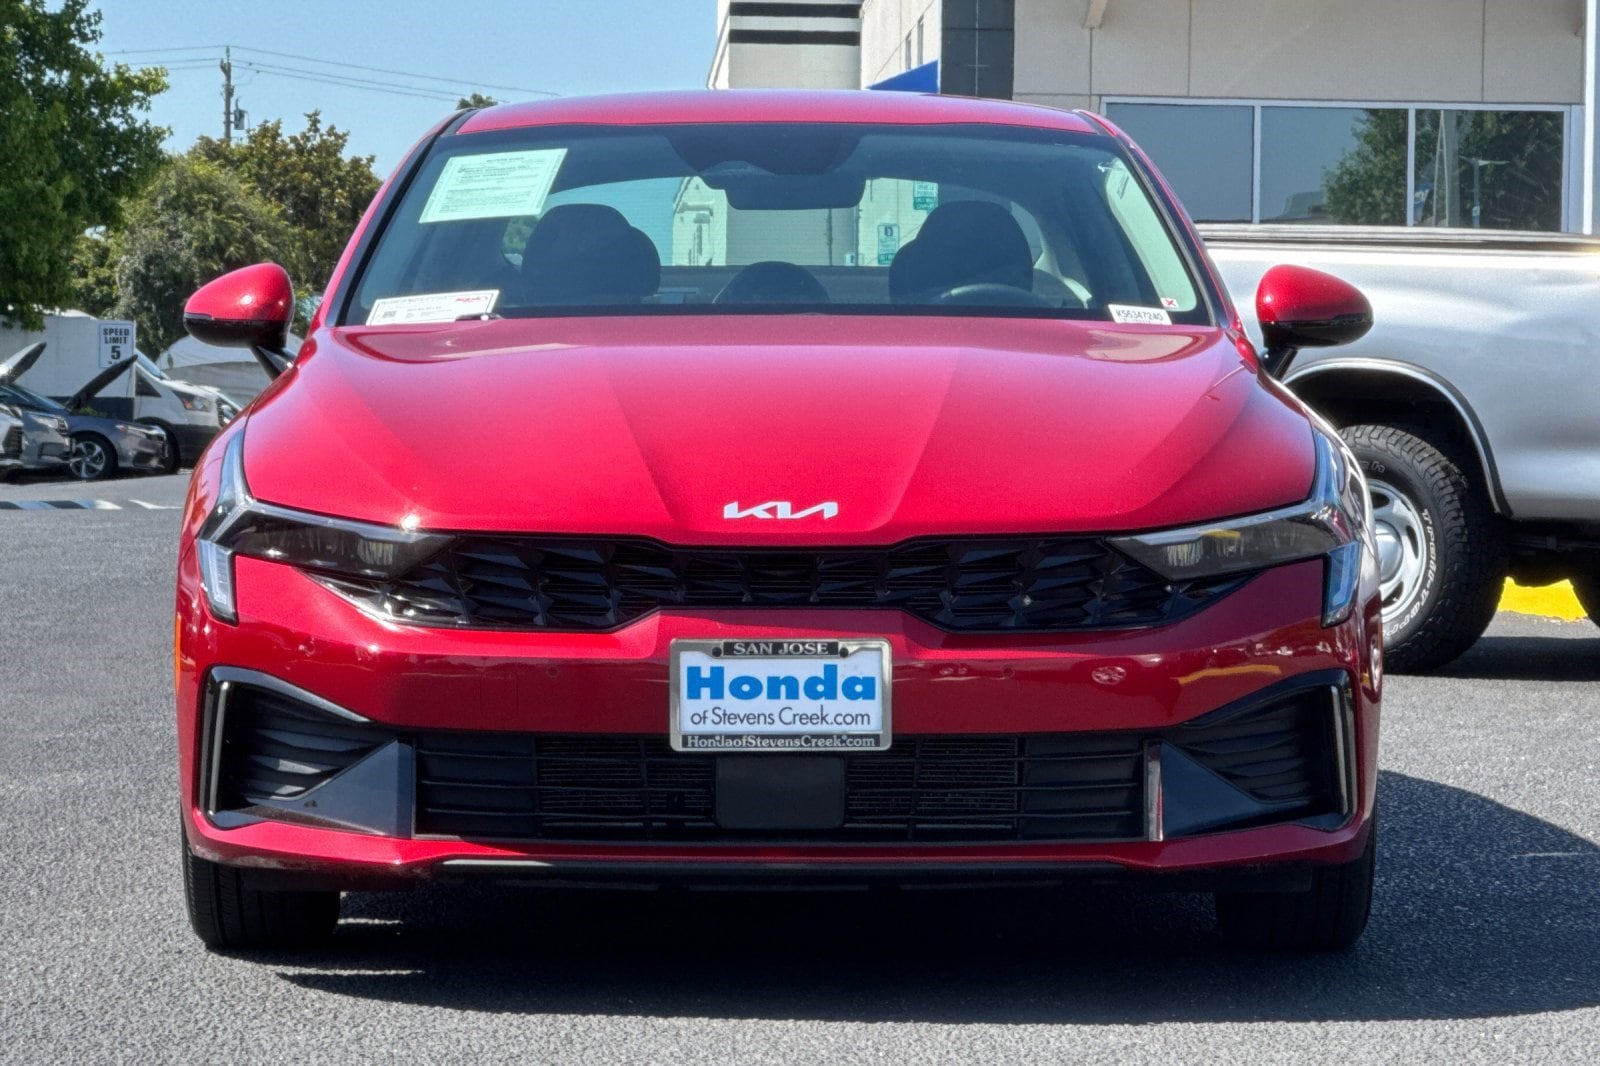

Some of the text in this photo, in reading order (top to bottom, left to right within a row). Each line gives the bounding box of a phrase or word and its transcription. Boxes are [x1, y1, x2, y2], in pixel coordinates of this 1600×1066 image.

[103, 327, 129, 335] SPEED
[104, 336, 128, 344] LIMIT
[111, 345, 121, 360] 5
[733, 642, 829, 655] SAN JOSE
[686, 663, 876, 700] Honda
[690, 704, 871, 725] of Stevens Creek.com
[687, 735, 875, 748] HondaofStevensCreek.com
